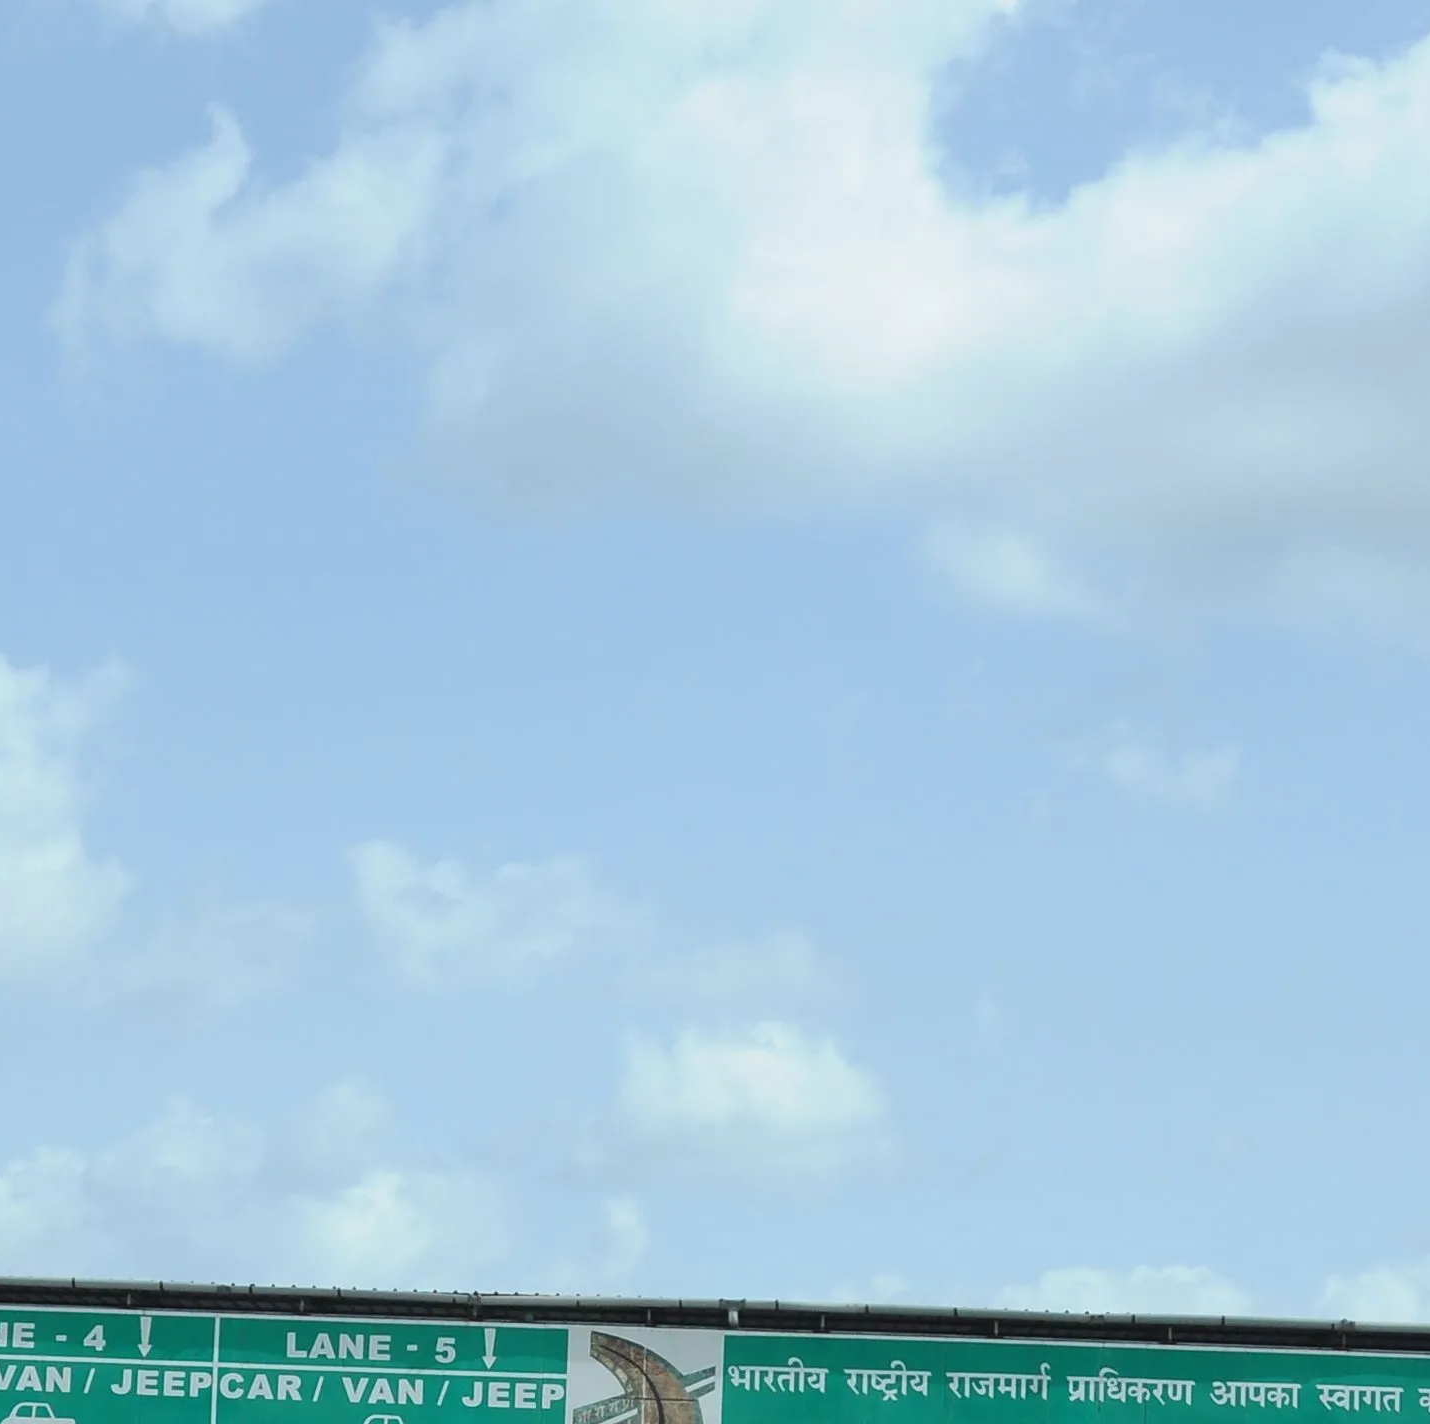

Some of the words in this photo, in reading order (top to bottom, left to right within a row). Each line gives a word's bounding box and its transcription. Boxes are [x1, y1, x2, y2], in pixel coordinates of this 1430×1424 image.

[84, 1326, 105, 1350] 4
[287, 1333, 390, 1360] LANE
[436, 1338, 455, 1363] 5
[112, 1369, 212, 1397] JEEP
[220, 1373, 301, 1400] CAR
[343, 1377, 423, 1404] VAN
[463, 1382, 564, 1408] JEEP
[729, 1357, 828, 1392] भारतीय
[846, 1360, 931, 1400] राष्ट्रीय
[947, 1363, 1050, 1400] राजमार्ग
[1068, 1367, 1195, 1404] प्राधिकरण
[1211, 1381, 1300, 1408] आपका
[1317, 1384, 1403, 1412] स्वागत
